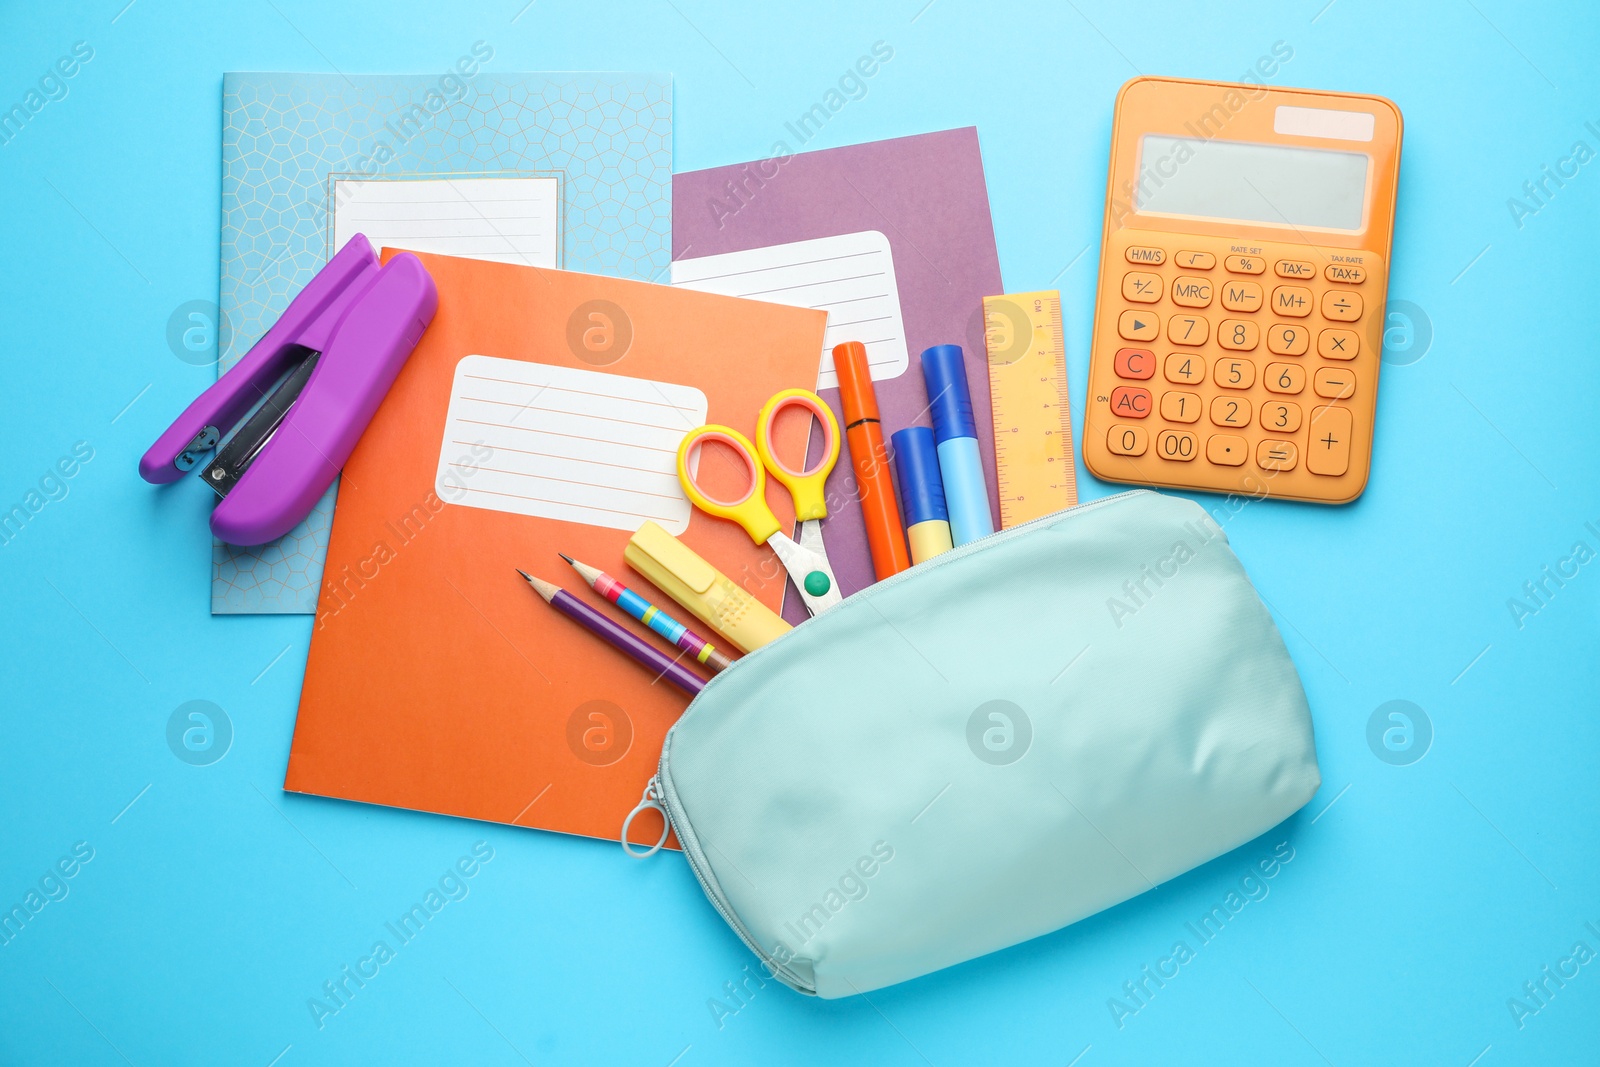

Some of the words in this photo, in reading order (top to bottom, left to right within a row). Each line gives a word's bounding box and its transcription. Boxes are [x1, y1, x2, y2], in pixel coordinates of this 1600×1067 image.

[1132, 249, 1161, 262] H/M/S
[1231, 246, 1247, 254] RATE
[1240, 258, 1252, 270] %
[1346, 256, 1363, 264] RATE
[1332, 268, 1360, 280] TAX+
[1176, 284, 1210, 300] MRC
[1280, 293, 1306, 308] M+
[1034, 300, 1042, 312] CM
[1183, 320, 1196, 340] 7
[1233, 324, 1246, 345] 8
[1282, 330, 1296, 350] 9
[1128, 354, 1143, 373] C
[1178, 359, 1192, 378] 4
[1228, 364, 1242, 384] 5
[1278, 368, 1292, 388] 6
[1117, 394, 1146, 412] AC
[1178, 398, 1185, 417] 1
[1225, 402, 1238, 422] 2
[1275, 406, 1288, 427] 3
[1122, 430, 1136, 450] 0
[1165, 435, 1192, 456] 00
